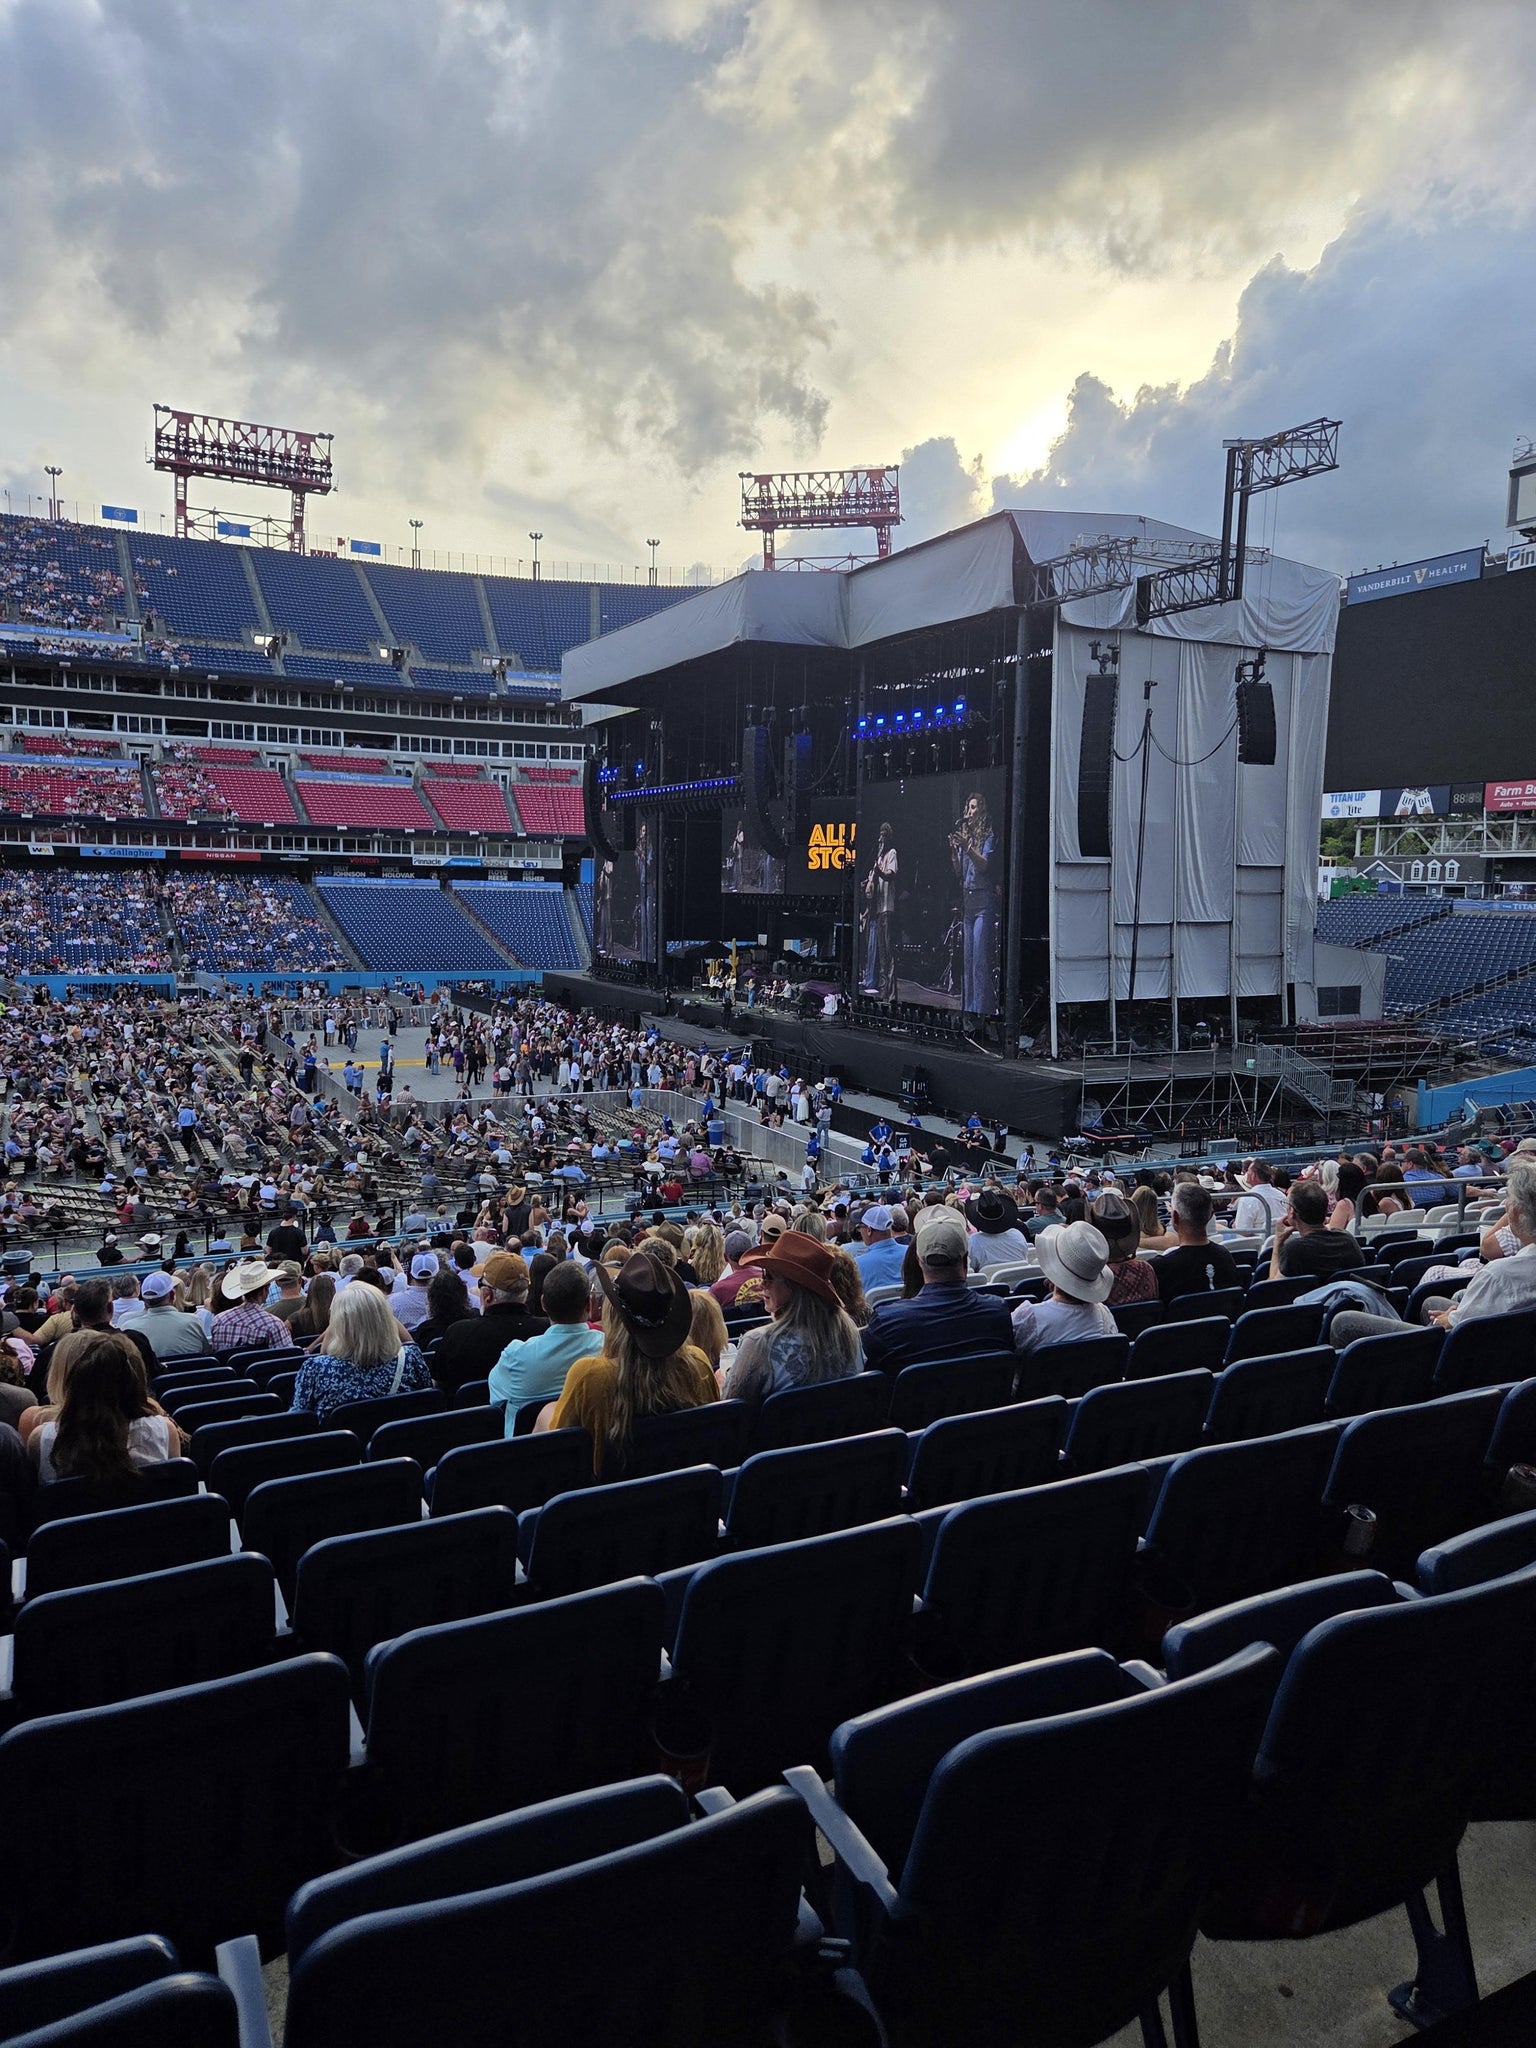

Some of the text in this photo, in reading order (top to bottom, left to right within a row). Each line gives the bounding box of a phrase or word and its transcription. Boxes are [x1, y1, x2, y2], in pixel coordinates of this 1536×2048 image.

[1509, 548, 1536, 568] Pin
[1356, 575, 1412, 593] VANDERBILT
[1428, 563, 1467, 577] HEALTH
[1494, 786, 1522, 796] Farm
[1330, 793, 1366, 803] TITAN UP
[1348, 805, 1362, 816] Lite
[109, 848, 154, 857] Gallagher
[413, 857, 442, 865] Pinnacle
[808, 847, 856, 869] STO
